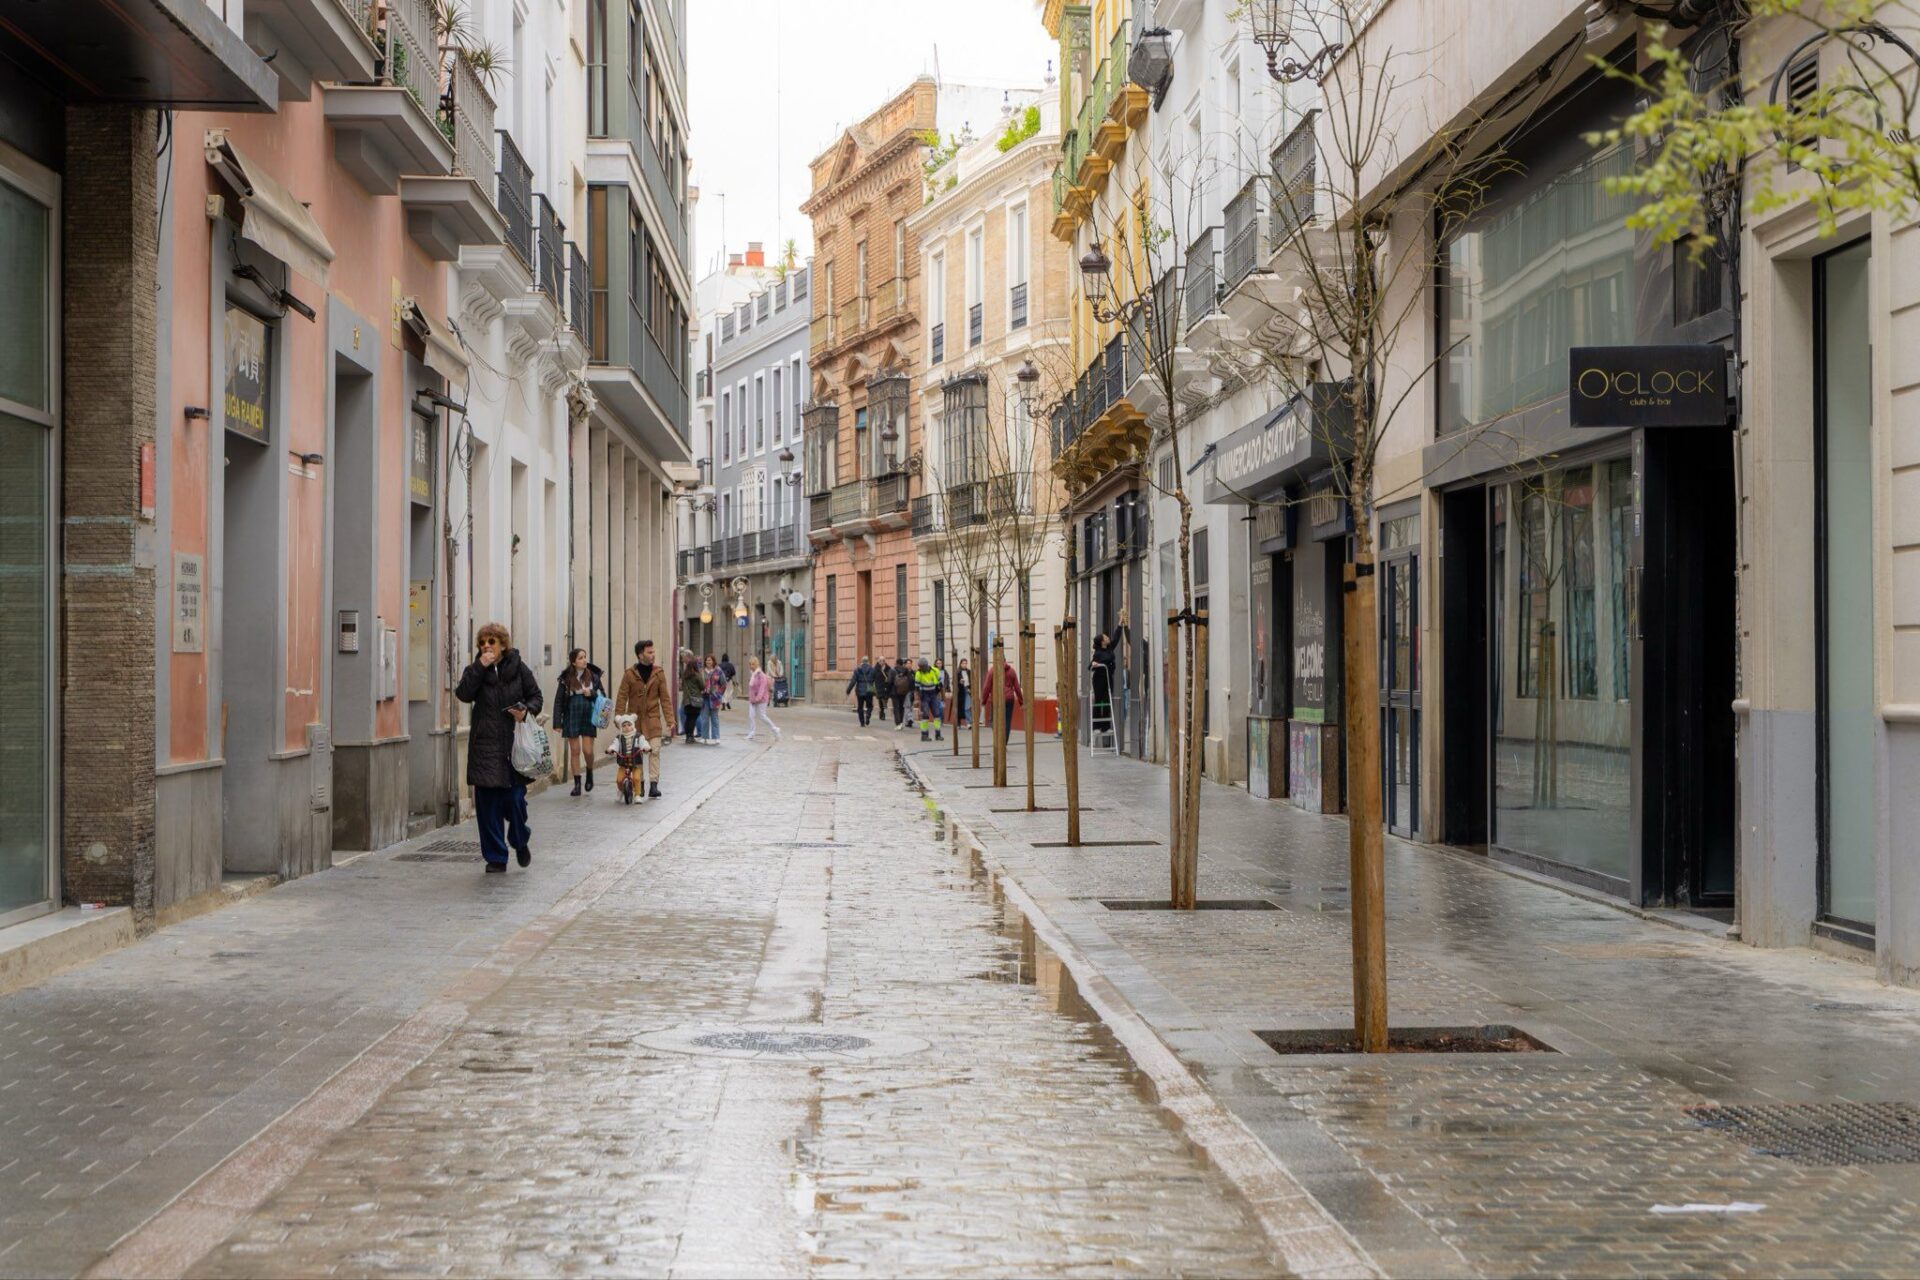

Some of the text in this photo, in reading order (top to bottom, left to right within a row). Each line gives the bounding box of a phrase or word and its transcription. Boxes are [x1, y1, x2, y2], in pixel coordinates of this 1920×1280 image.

[1578, 368, 1714, 399] O'CLOCK
[242, 400, 264, 430] RAMEN
[1216, 434, 1262, 486] MINIMERCADO
[1294, 641, 1324, 678] WELCOME
